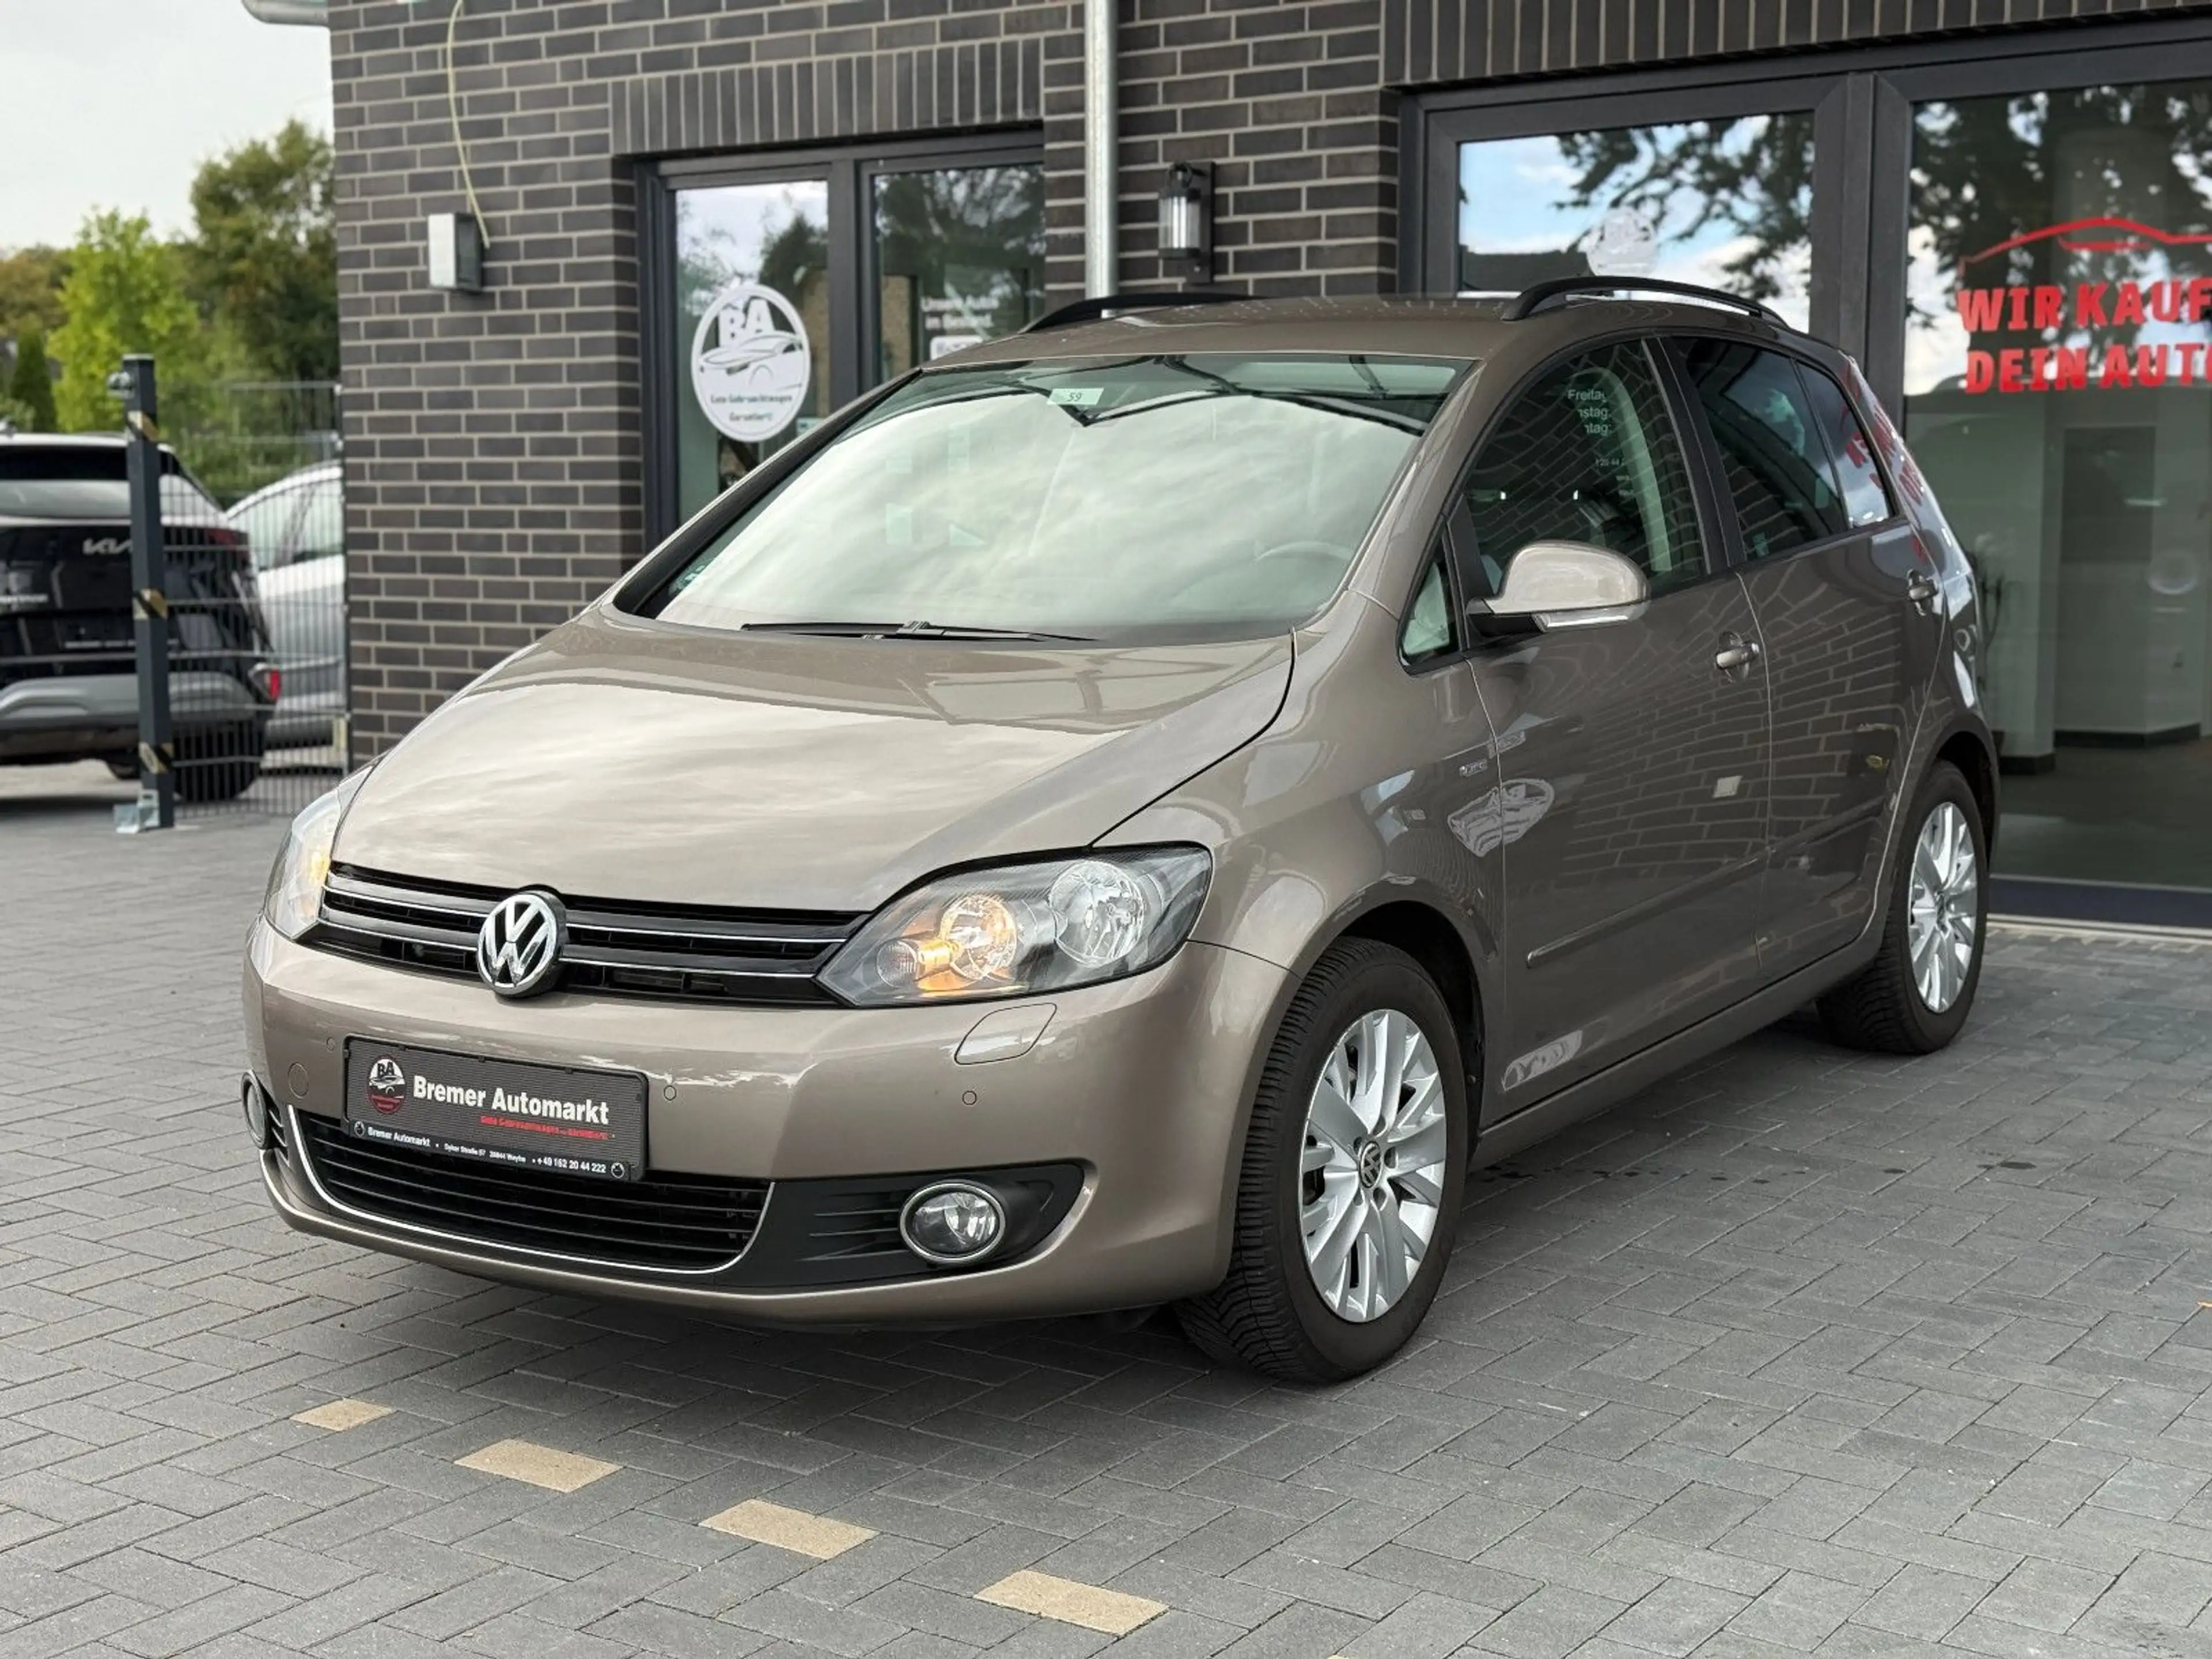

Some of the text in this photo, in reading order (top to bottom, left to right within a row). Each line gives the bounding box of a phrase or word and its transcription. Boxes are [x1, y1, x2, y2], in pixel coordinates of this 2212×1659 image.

[718, 297, 775, 347] BA
[1959, 276, 2212, 332] WIR KAUF
[1965, 343, 2212, 395] DEIN AUT
[413, 1075, 609, 1124] Bremer Automarkt
[368, 1126, 431, 1147] Bremer Automarkt
[569, 1159, 578, 1169] 20
[580, 1161, 590, 1171] 44
[592, 1162, 606, 1173] 222
